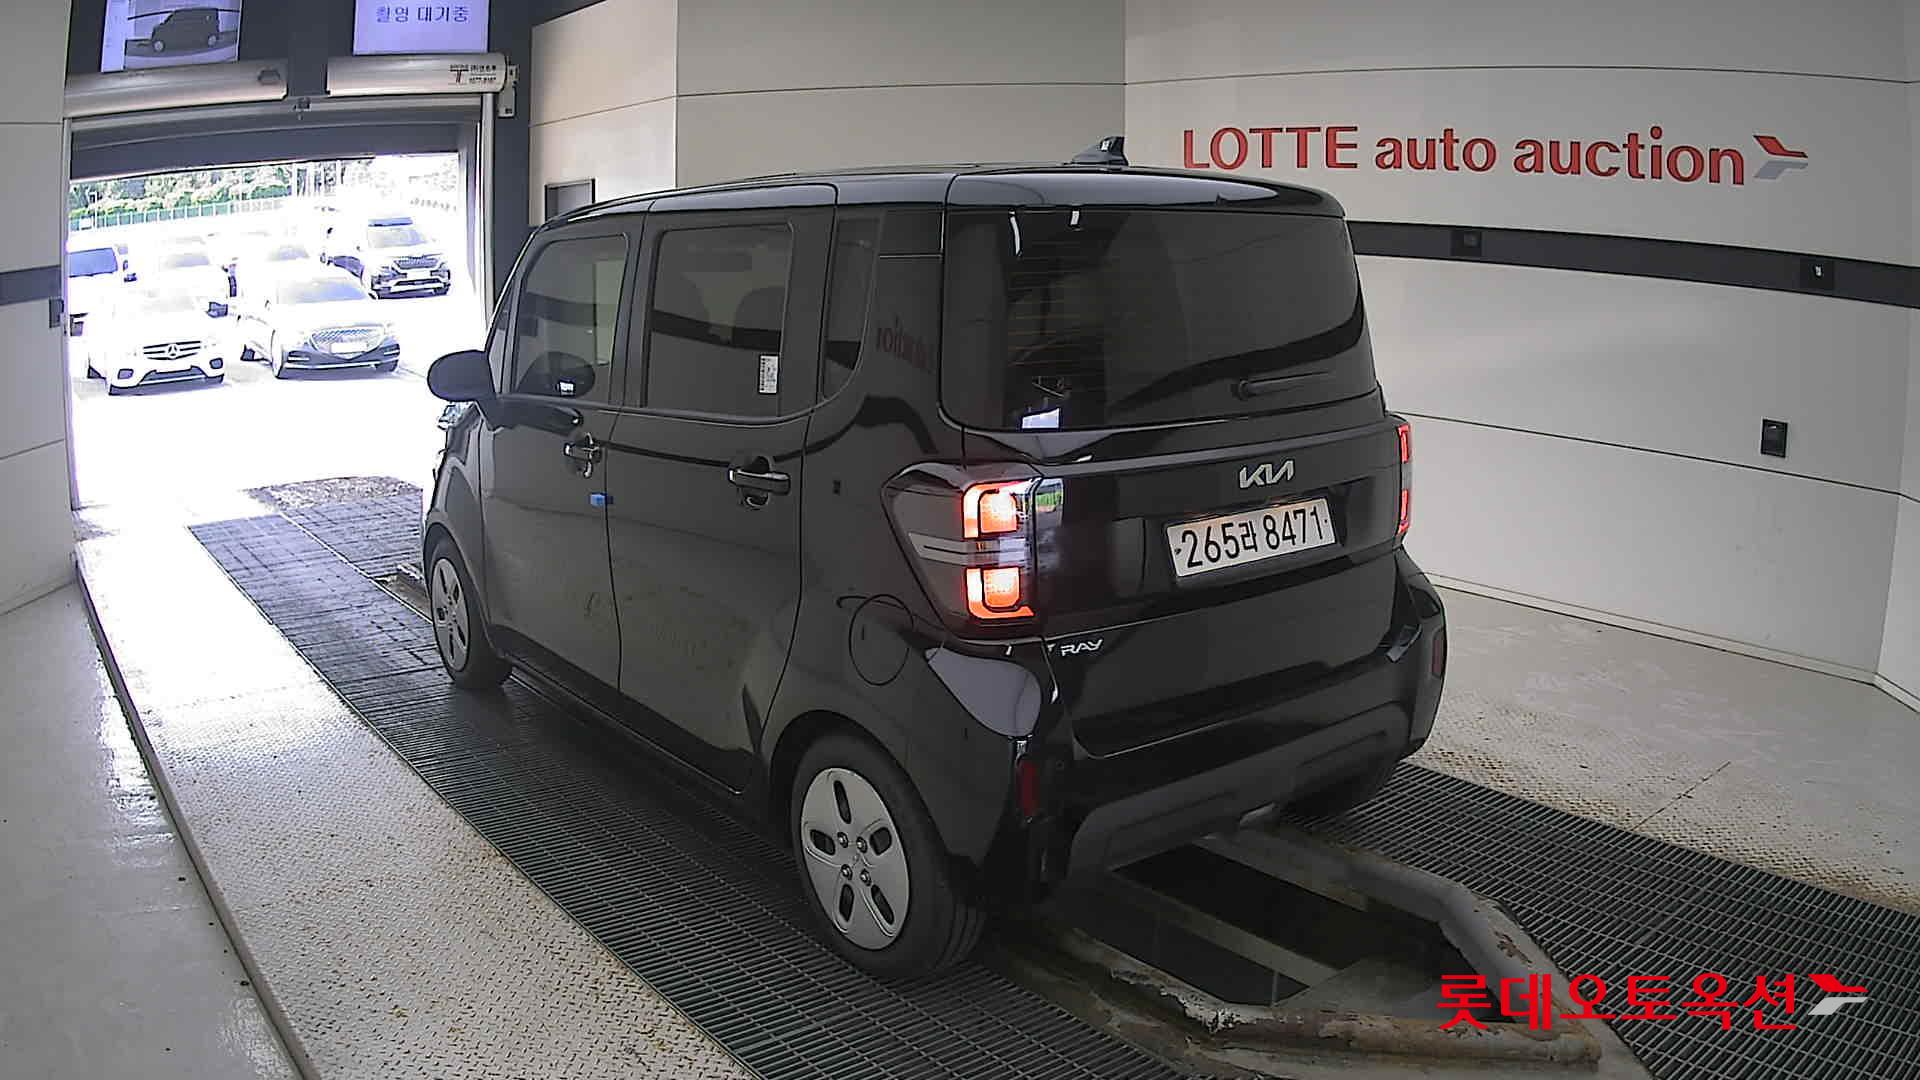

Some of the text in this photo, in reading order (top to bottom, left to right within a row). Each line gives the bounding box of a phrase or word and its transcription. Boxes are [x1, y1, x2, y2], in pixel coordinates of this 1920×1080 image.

[417, 6, 469, 23] 대기중
[1183, 126, 1744, 185] LOTTE auto auction
[1239, 460, 1295, 489] KIA
[1181, 506, 1324, 569] 265라 8471
[1060, 639, 1103, 657] RAY
